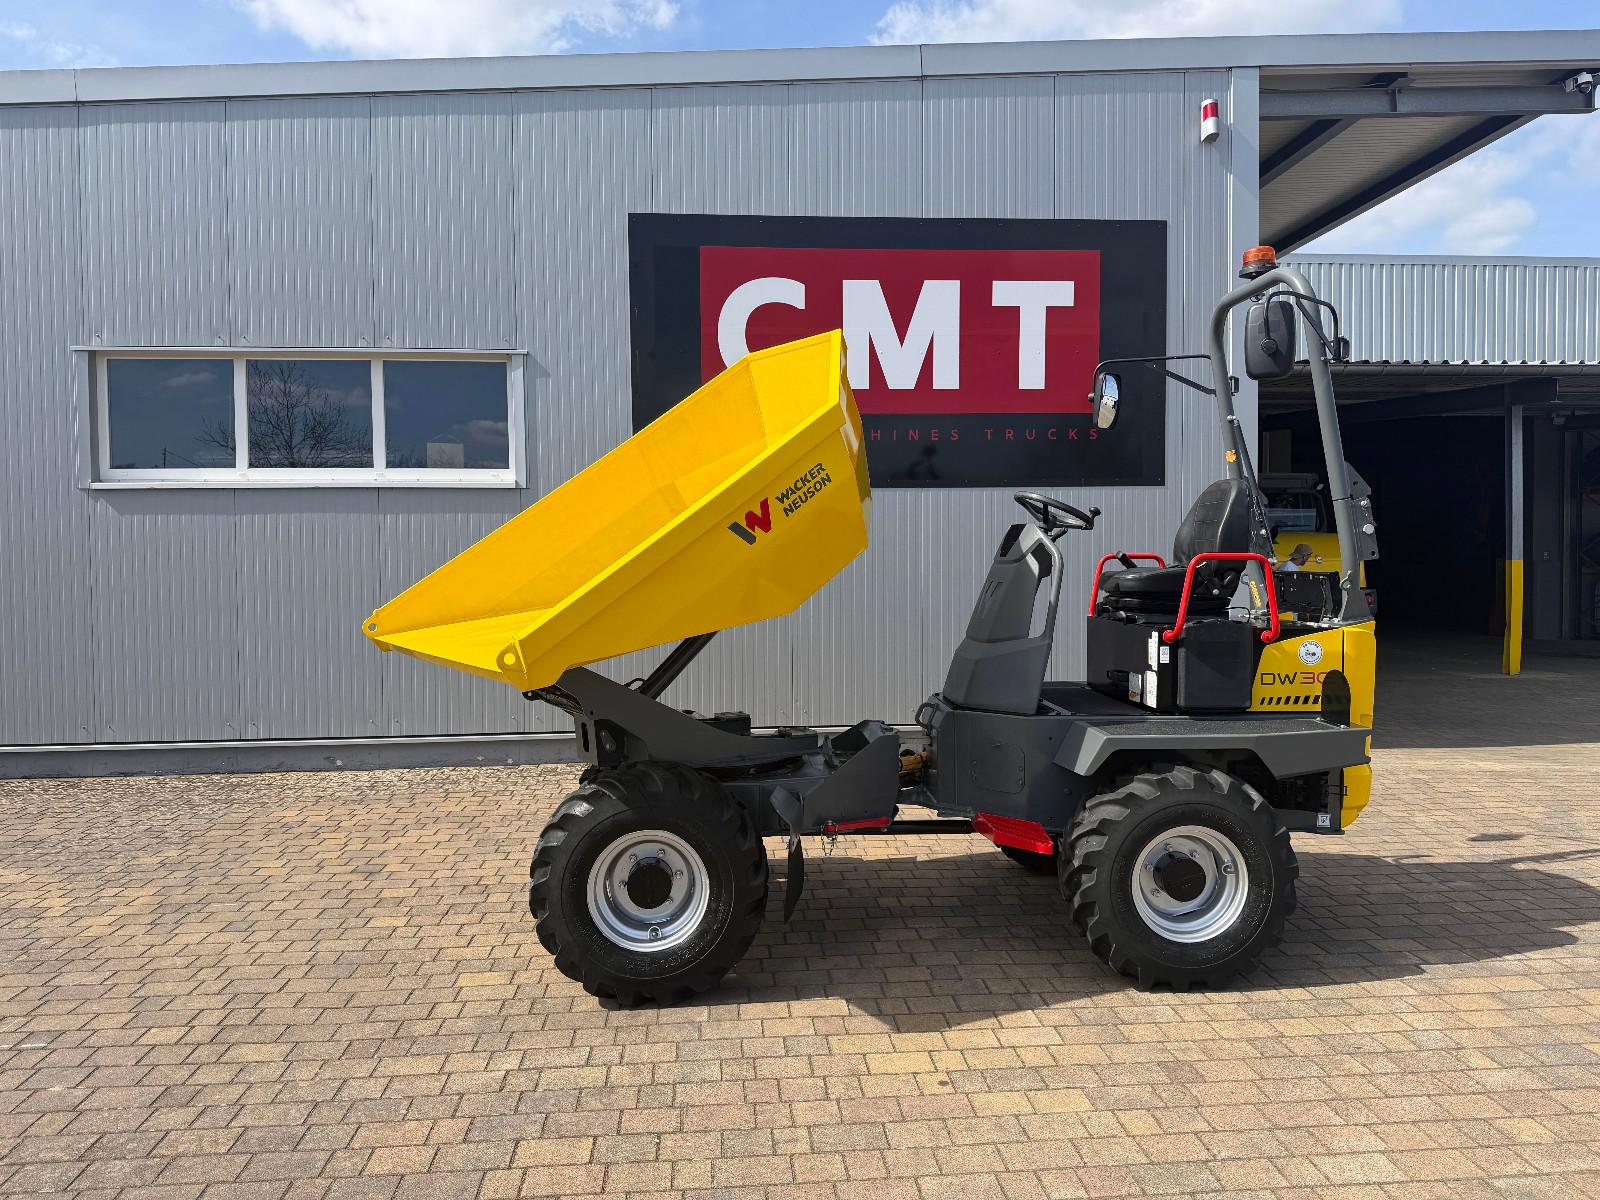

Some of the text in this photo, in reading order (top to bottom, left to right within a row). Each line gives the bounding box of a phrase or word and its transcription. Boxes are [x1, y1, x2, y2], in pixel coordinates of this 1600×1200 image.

[717, 277, 1075, 390] CMT
[871, 428, 1099, 441] HINES TRUCKS
[775, 462, 827, 505] WACKER
[782, 472, 832, 518] NEUSON
